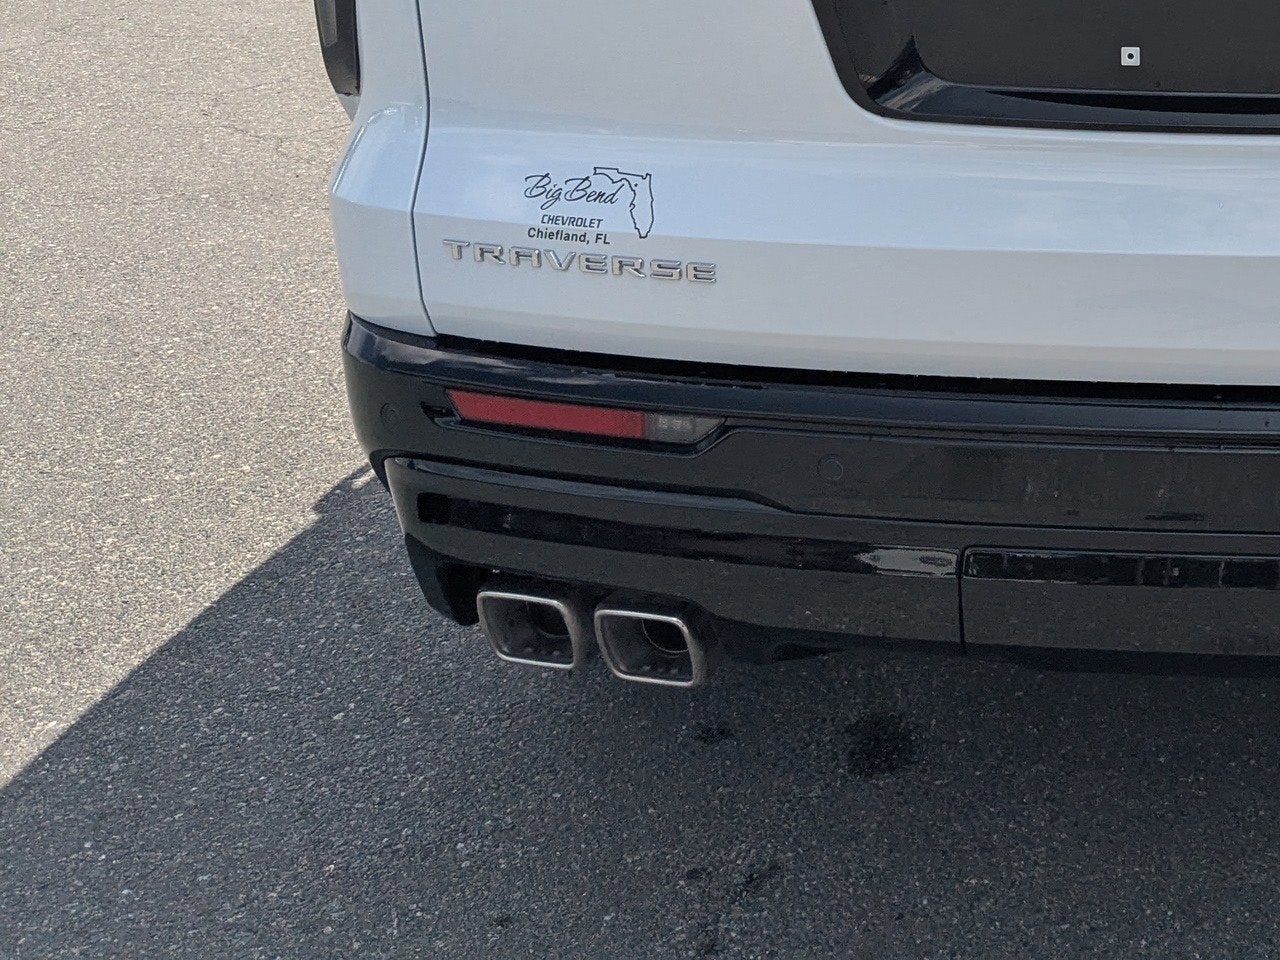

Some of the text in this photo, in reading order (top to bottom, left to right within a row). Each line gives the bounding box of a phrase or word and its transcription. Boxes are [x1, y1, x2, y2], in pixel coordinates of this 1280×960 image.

[524, 172, 625, 211] Big Bend
[541, 214, 604, 229] CHEVROLET
[527, 227, 611, 245] Chiefland, FL
[442, 238, 718, 284] TRAVERSE
